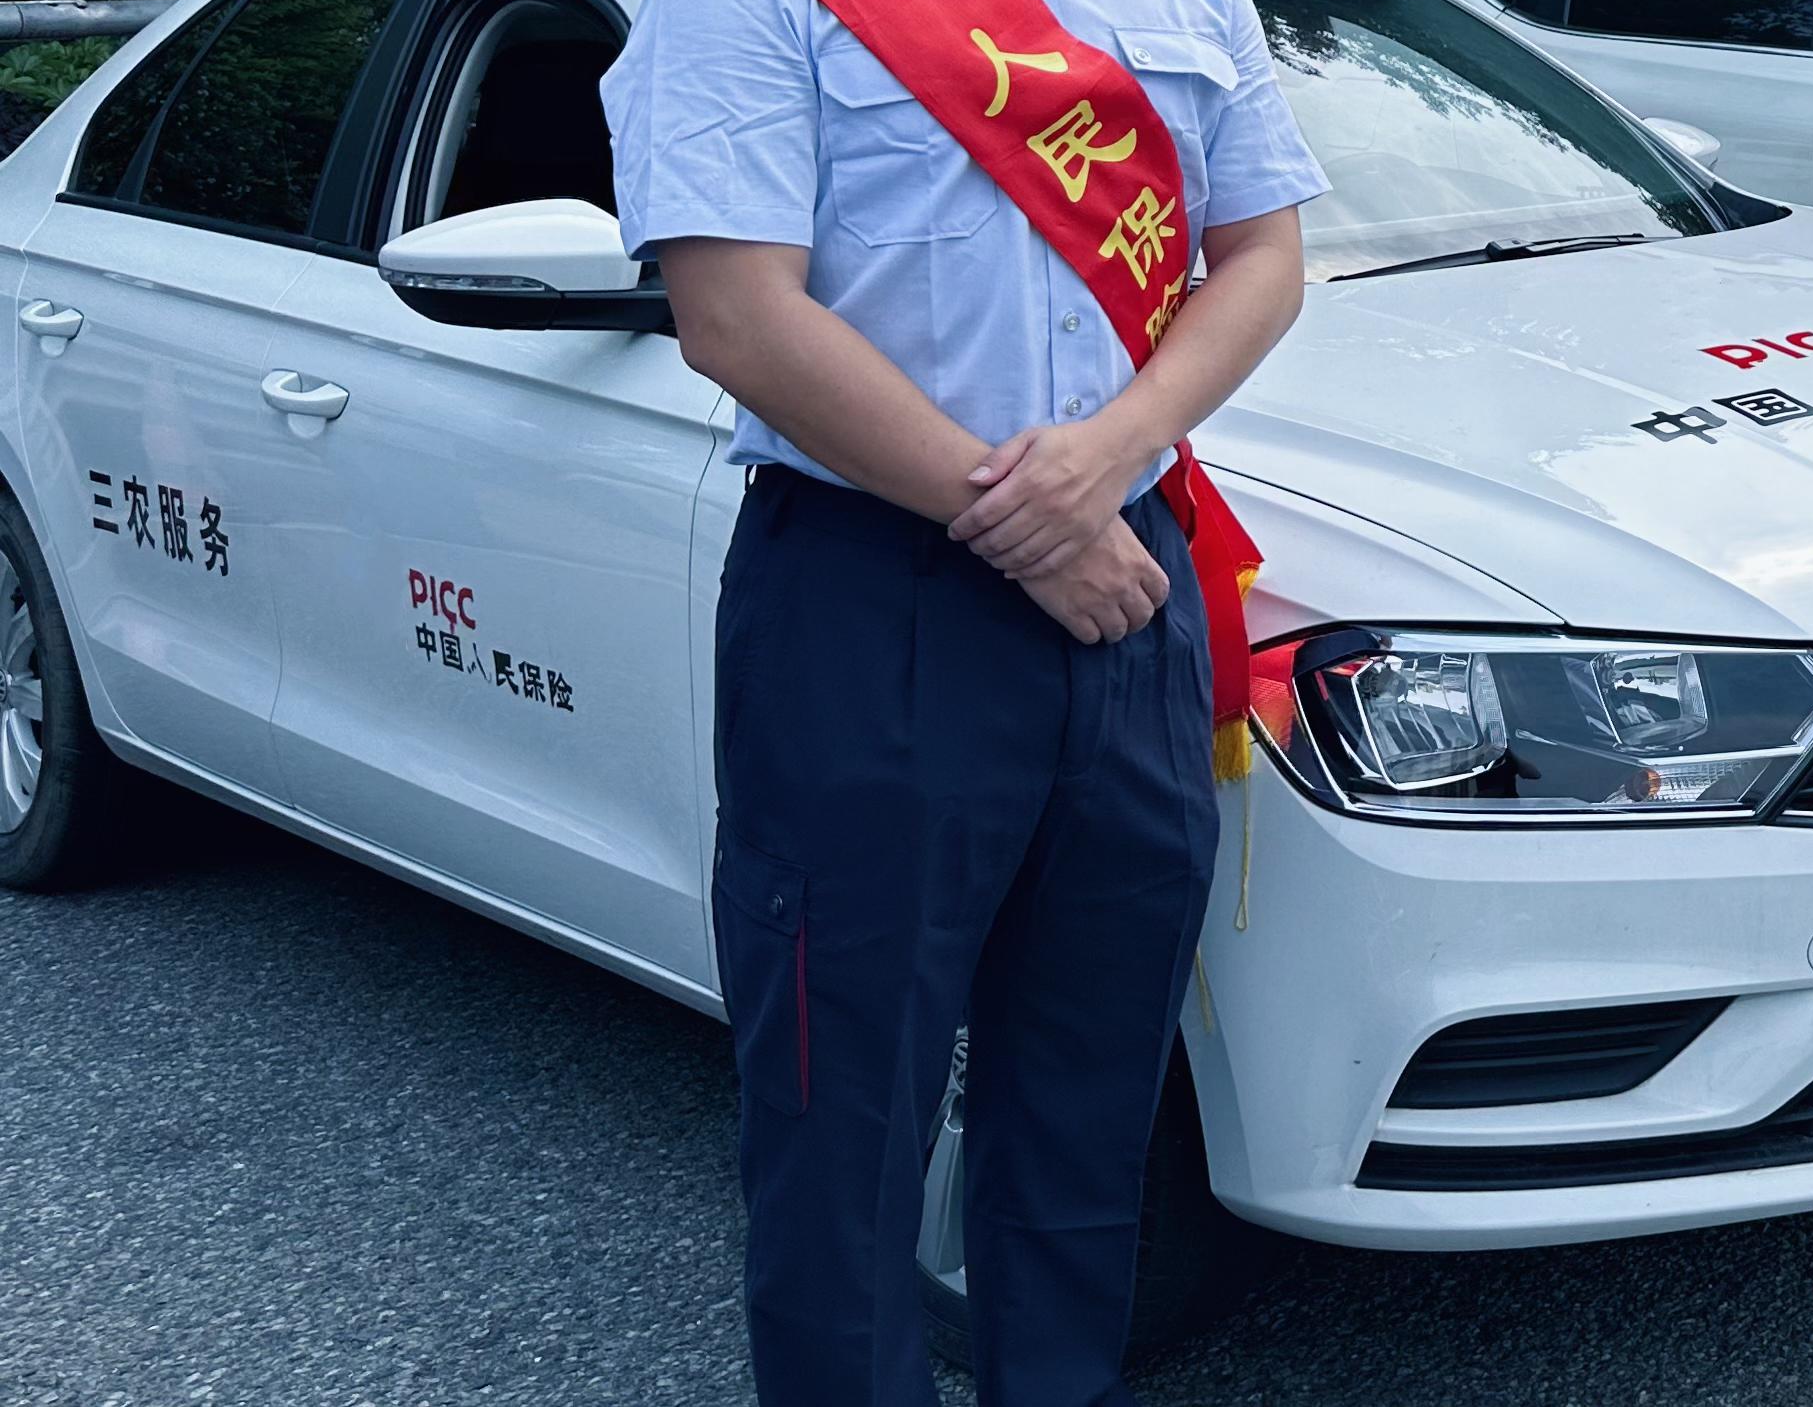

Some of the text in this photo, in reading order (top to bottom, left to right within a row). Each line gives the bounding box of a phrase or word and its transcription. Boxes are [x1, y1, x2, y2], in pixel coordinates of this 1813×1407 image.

[89, 469, 230, 577] 三农服务
[408, 569, 477, 631] PICC
